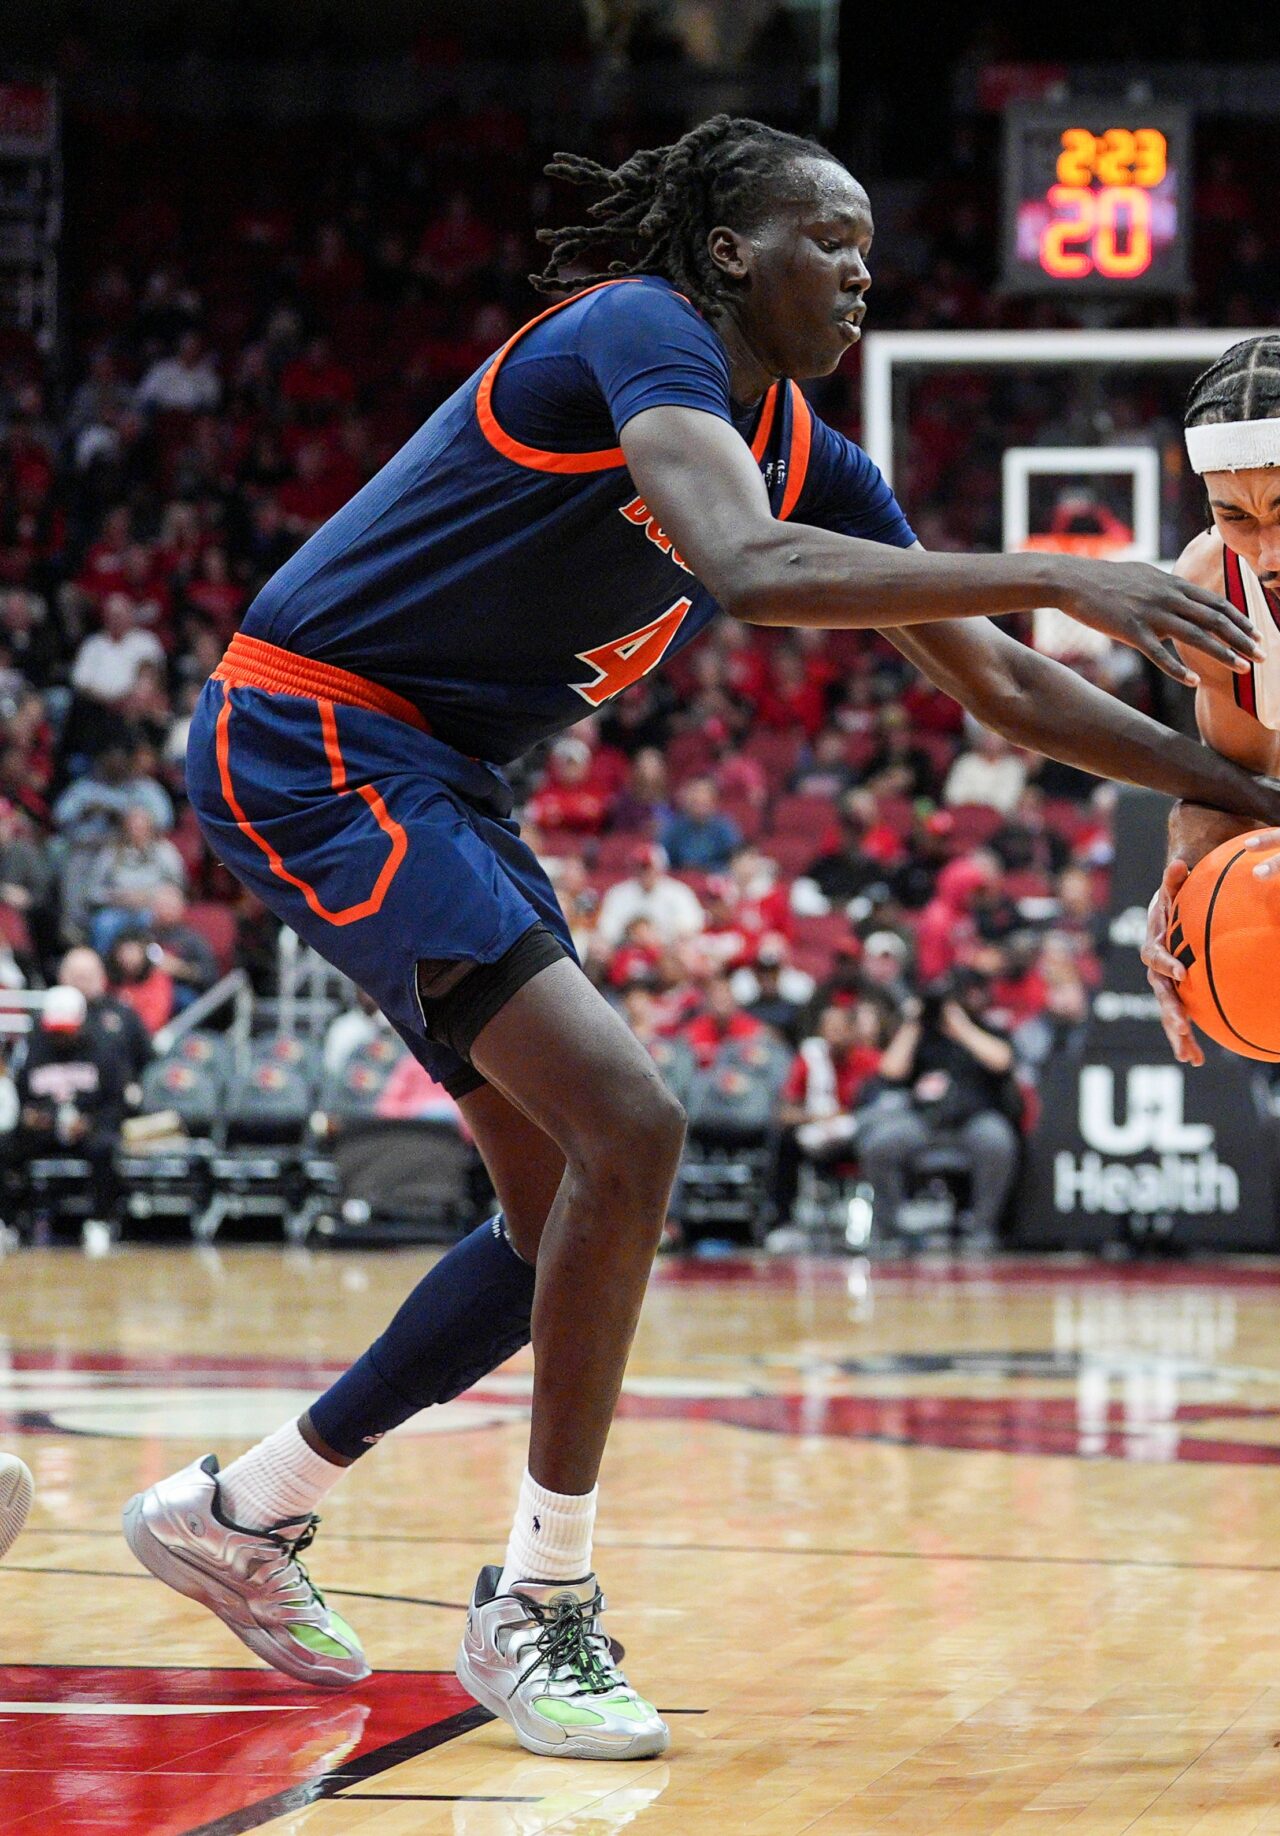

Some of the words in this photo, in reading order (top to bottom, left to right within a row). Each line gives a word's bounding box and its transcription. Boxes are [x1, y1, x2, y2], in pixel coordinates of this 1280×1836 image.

[1056, 128, 1167, 187] 2:23
[1040, 183, 1152, 278] 20
[566, 596, 692, 707] 4
[1078, 1063, 1215, 1156] UL
[1053, 1149, 1240, 1214] Health
